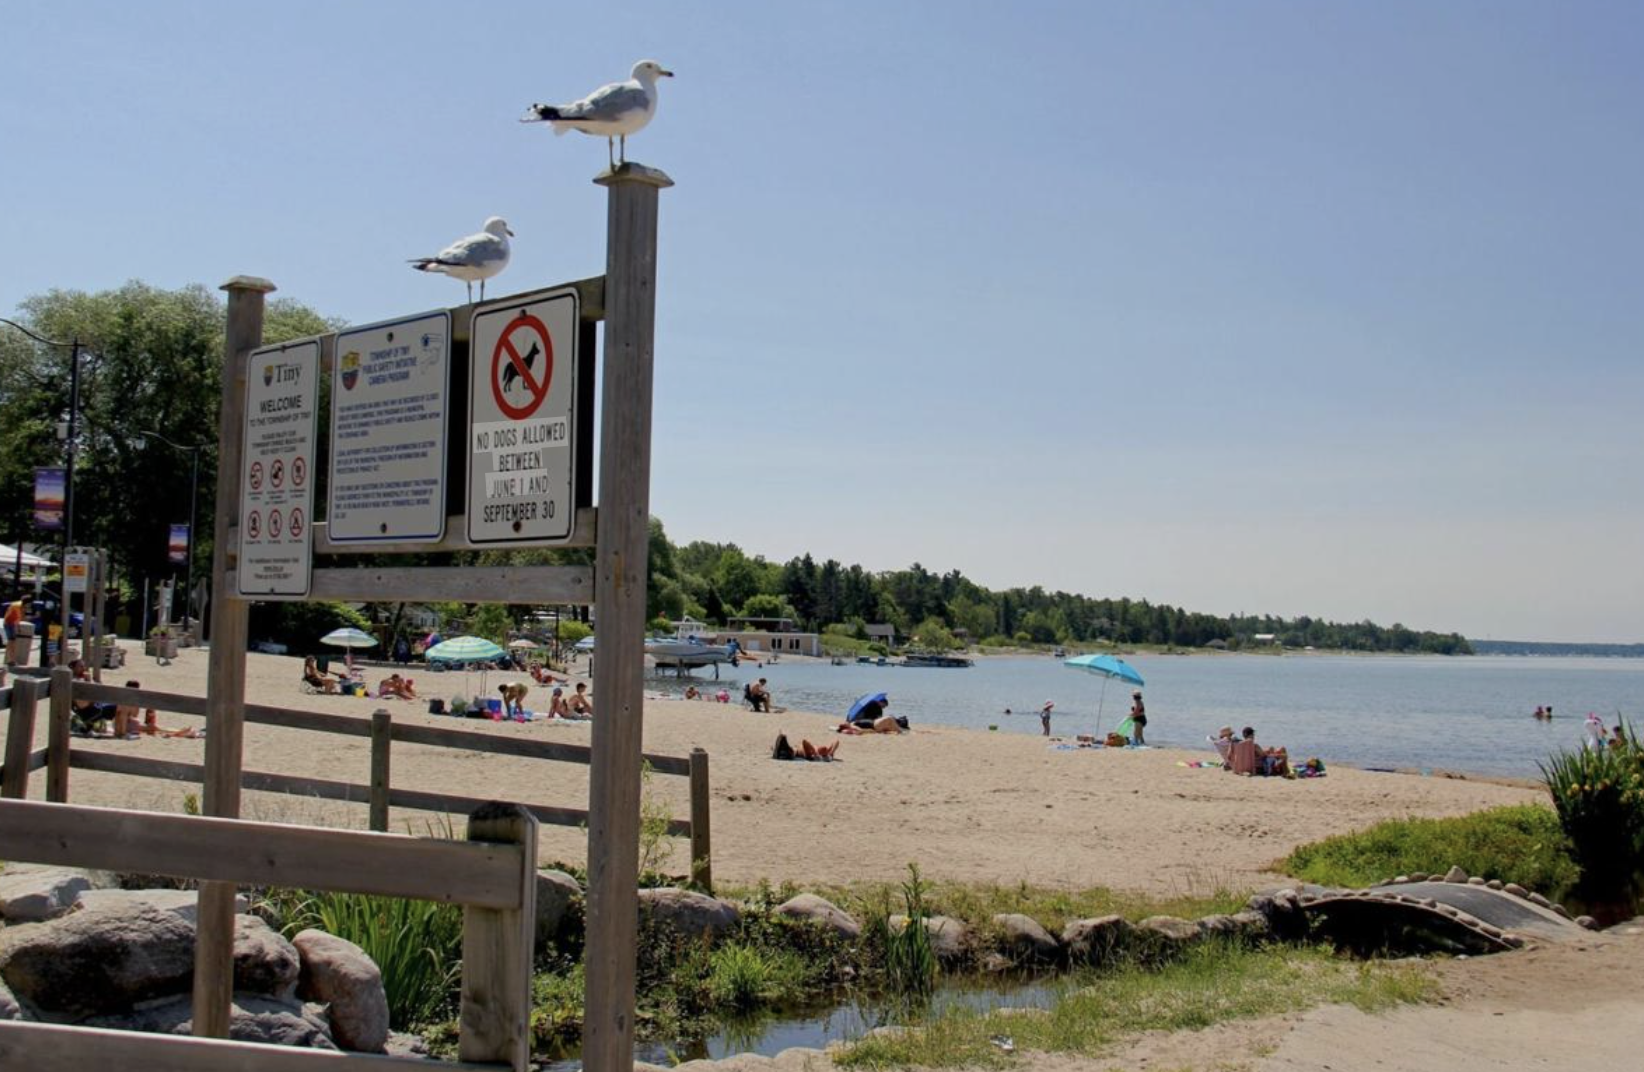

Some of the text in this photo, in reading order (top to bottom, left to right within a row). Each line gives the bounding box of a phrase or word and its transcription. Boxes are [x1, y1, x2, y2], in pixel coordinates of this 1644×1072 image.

[275, 364, 301, 386] Tiny
[260, 395, 302, 413] WELCOME
[267, 414, 291, 425] TOWNSHIP
[292, 413, 299, 422] OF
[477, 422, 565, 450] NO DOGS ALLOWED
[499, 450, 541, 472] BETWEEN
[491, 476, 548, 498] JUNE 1 AND
[483, 500, 555, 522] SEPTEMBER 30
